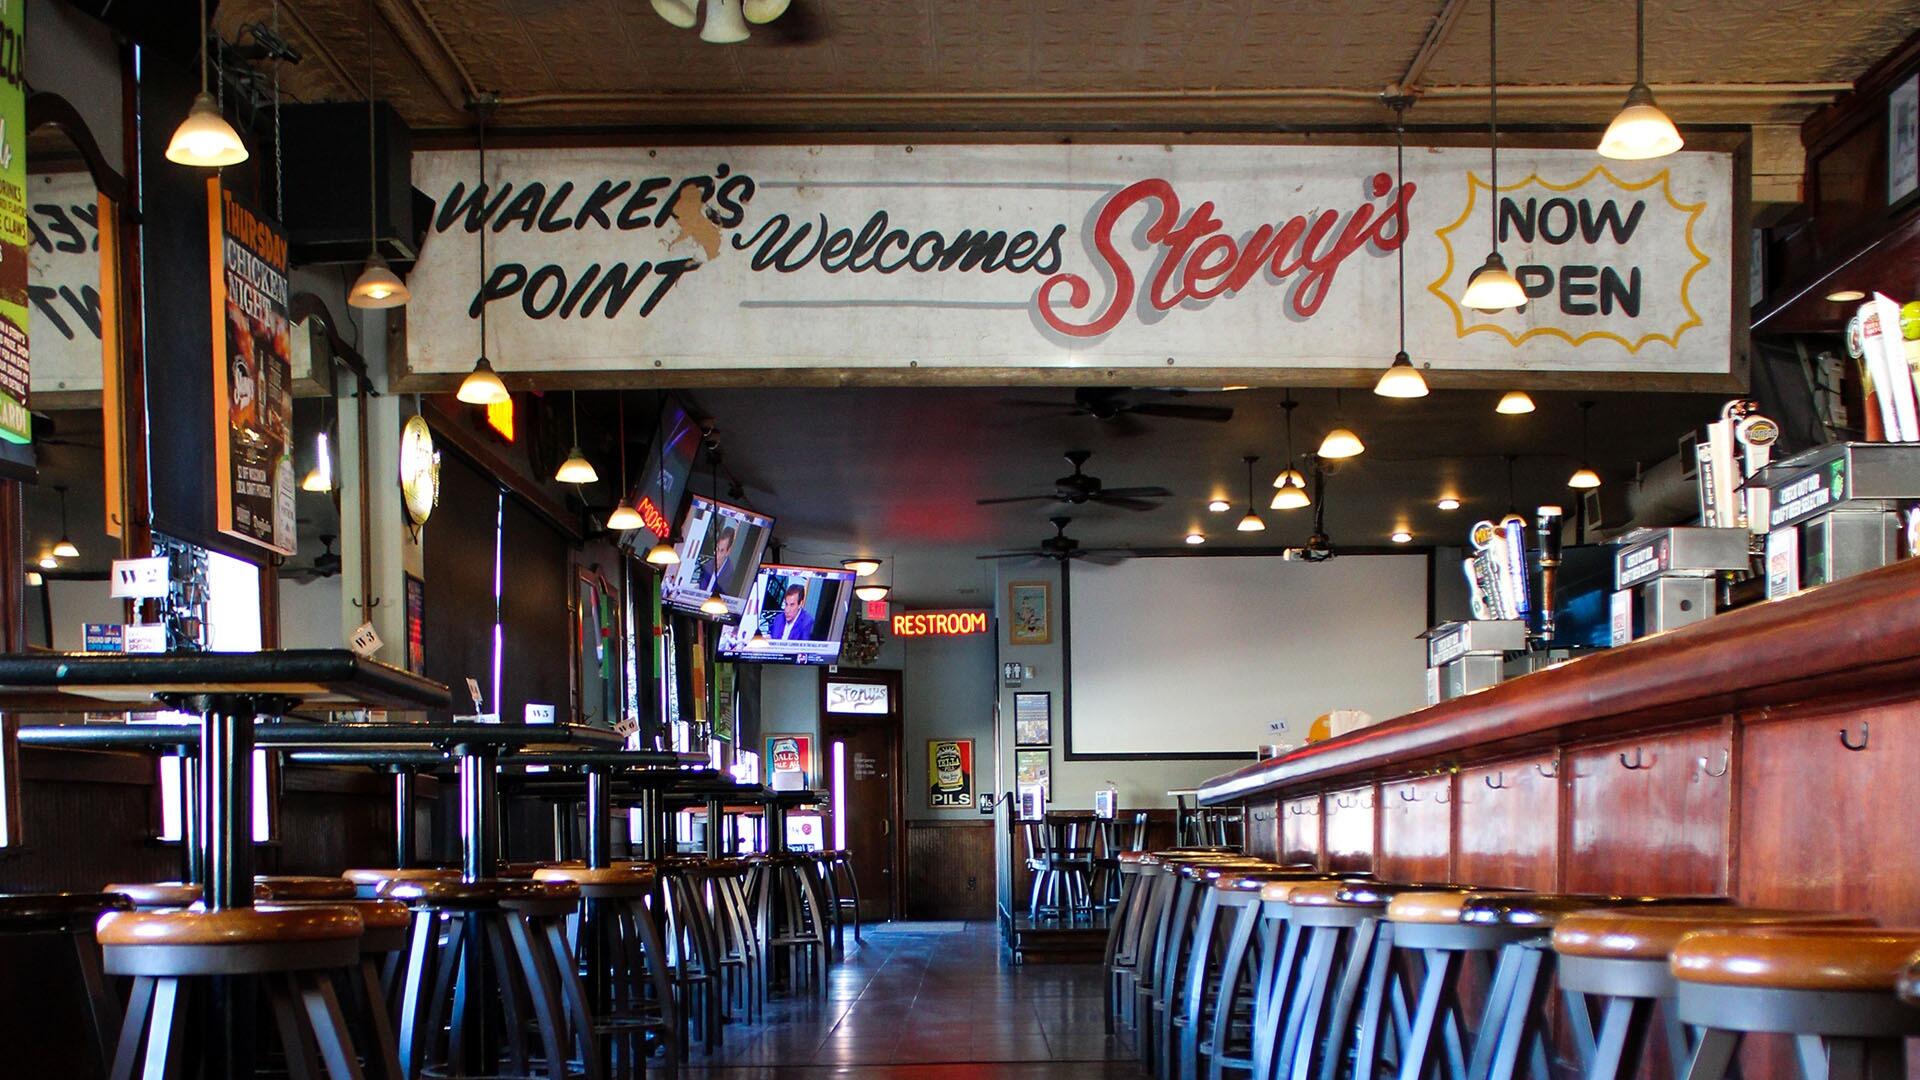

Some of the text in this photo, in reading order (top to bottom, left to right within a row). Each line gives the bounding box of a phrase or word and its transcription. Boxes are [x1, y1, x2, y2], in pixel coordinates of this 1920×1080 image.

[436, 162, 756, 233] WALKER'S
[1499, 197, 1646, 245] NOW
[223, 189, 288, 273] THURSDAY
[732, 172, 1416, 338] Welcomes Steny's
[226, 237, 288, 308] CHICKEN
[227, 270, 272, 327] NIGHT
[469, 256, 703, 320] POINT
[0, 401, 27, 434] ARDI
[893, 612, 986, 635] RESTROOM
[932, 793, 970, 805] PILS
